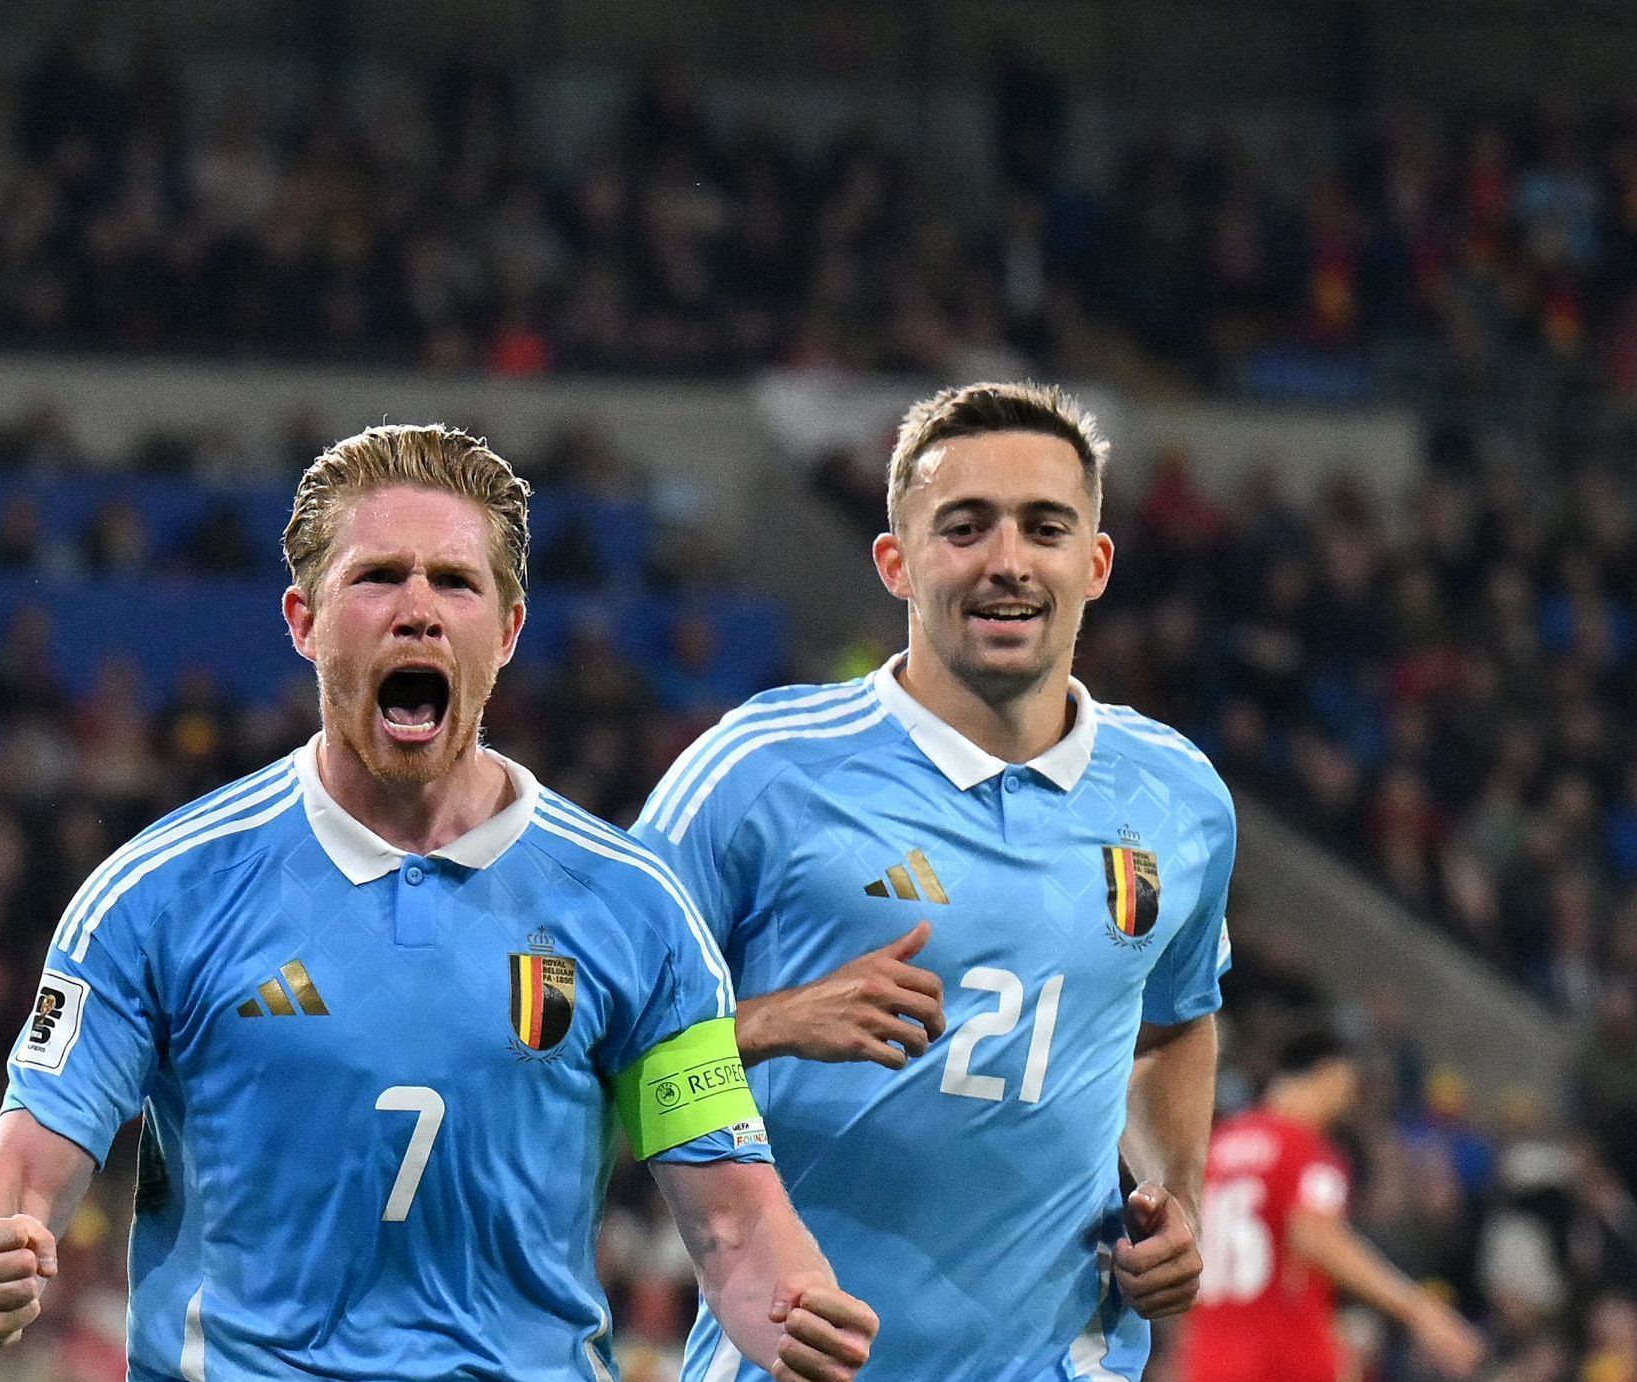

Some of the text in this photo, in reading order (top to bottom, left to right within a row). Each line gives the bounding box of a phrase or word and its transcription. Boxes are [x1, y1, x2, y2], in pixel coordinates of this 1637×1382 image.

[543, 959, 566, 969] ROYAL
[543, 967, 574, 977] BELGIAN
[940, 967, 1065, 1103] 21
[688, 1064, 745, 1094] RESPEC
[732, 1122, 750, 1131] UEFA
[374, 1086, 446, 1222] 7
